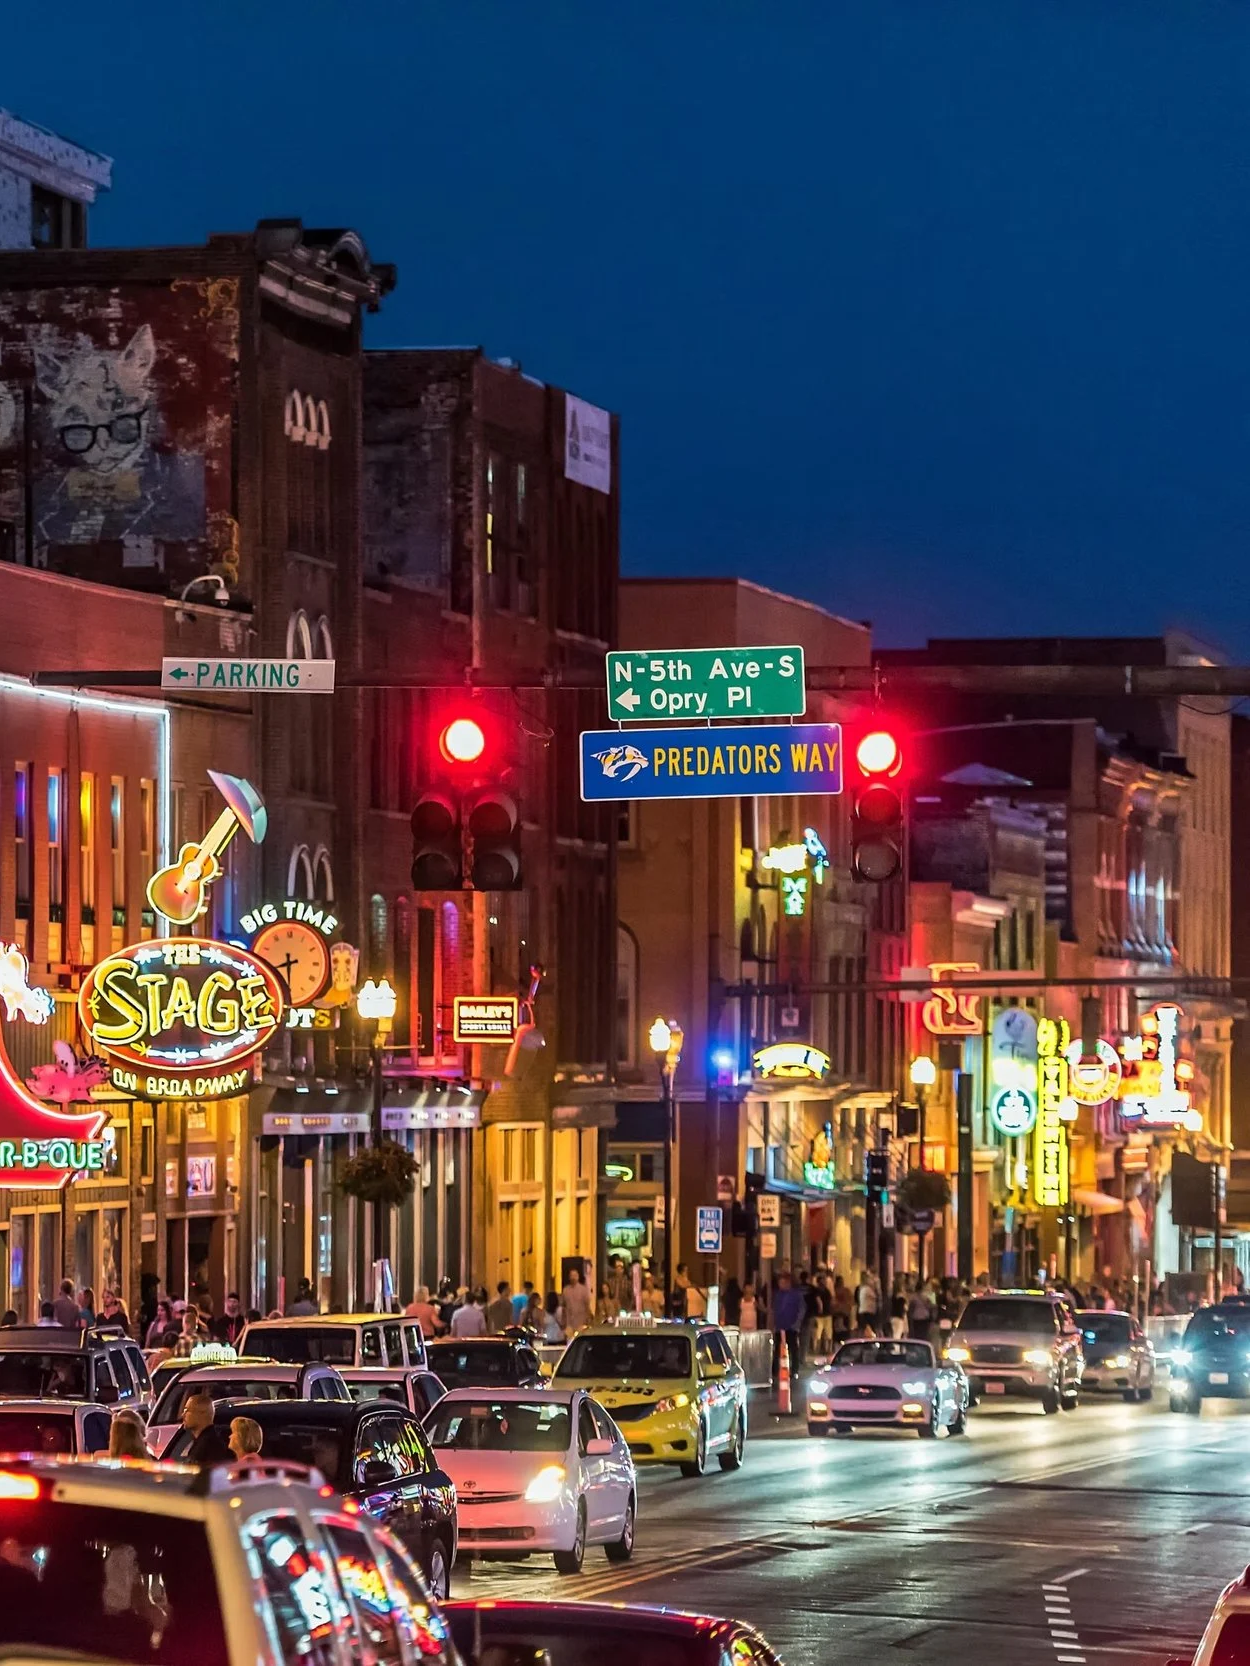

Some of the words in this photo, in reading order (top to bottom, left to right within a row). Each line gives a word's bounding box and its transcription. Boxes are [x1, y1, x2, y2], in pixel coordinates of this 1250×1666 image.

[196, 662, 300, 688] PARKING
[650, 687, 708, 714] Opry
[727, 687, 752, 708] Pl
[653, 744, 781, 777] PREDATORS
[790, 743, 838, 773] WAY
[238, 903, 278, 935] BIG
[282, 901, 339, 936] TIME
[161, 944, 202, 966] THE
[91, 958, 277, 1046] STAGE
[112, 1067, 138, 1092] ON
[146, 1069, 248, 1097] BROADWAY
[700, 1219, 720, 1229] STAND
[703, 1209, 718, 1219] TAXI
